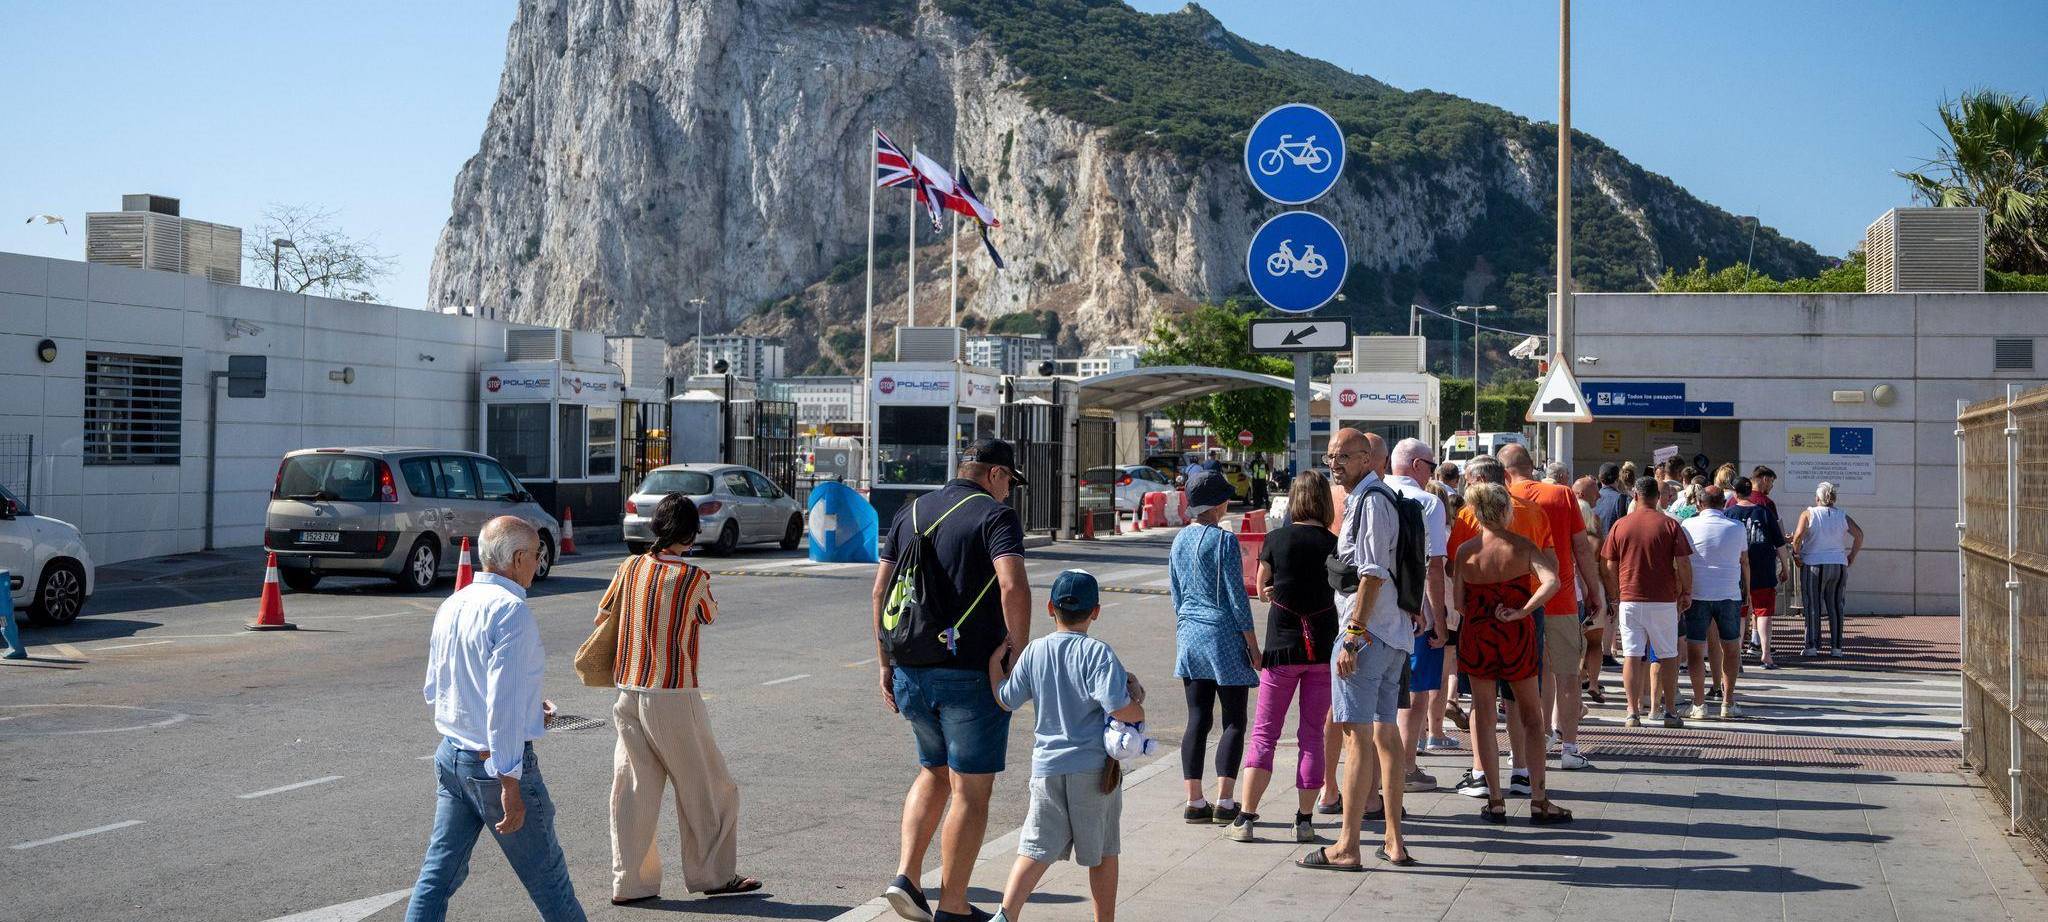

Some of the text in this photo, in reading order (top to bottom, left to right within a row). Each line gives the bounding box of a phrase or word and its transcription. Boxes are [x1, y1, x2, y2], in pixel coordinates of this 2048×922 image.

[487, 380, 501, 389] STOP
[880, 381, 895, 390] STOP
[1340, 394, 1356, 403] STOP
[1653, 393, 1682, 401] pasaportes
